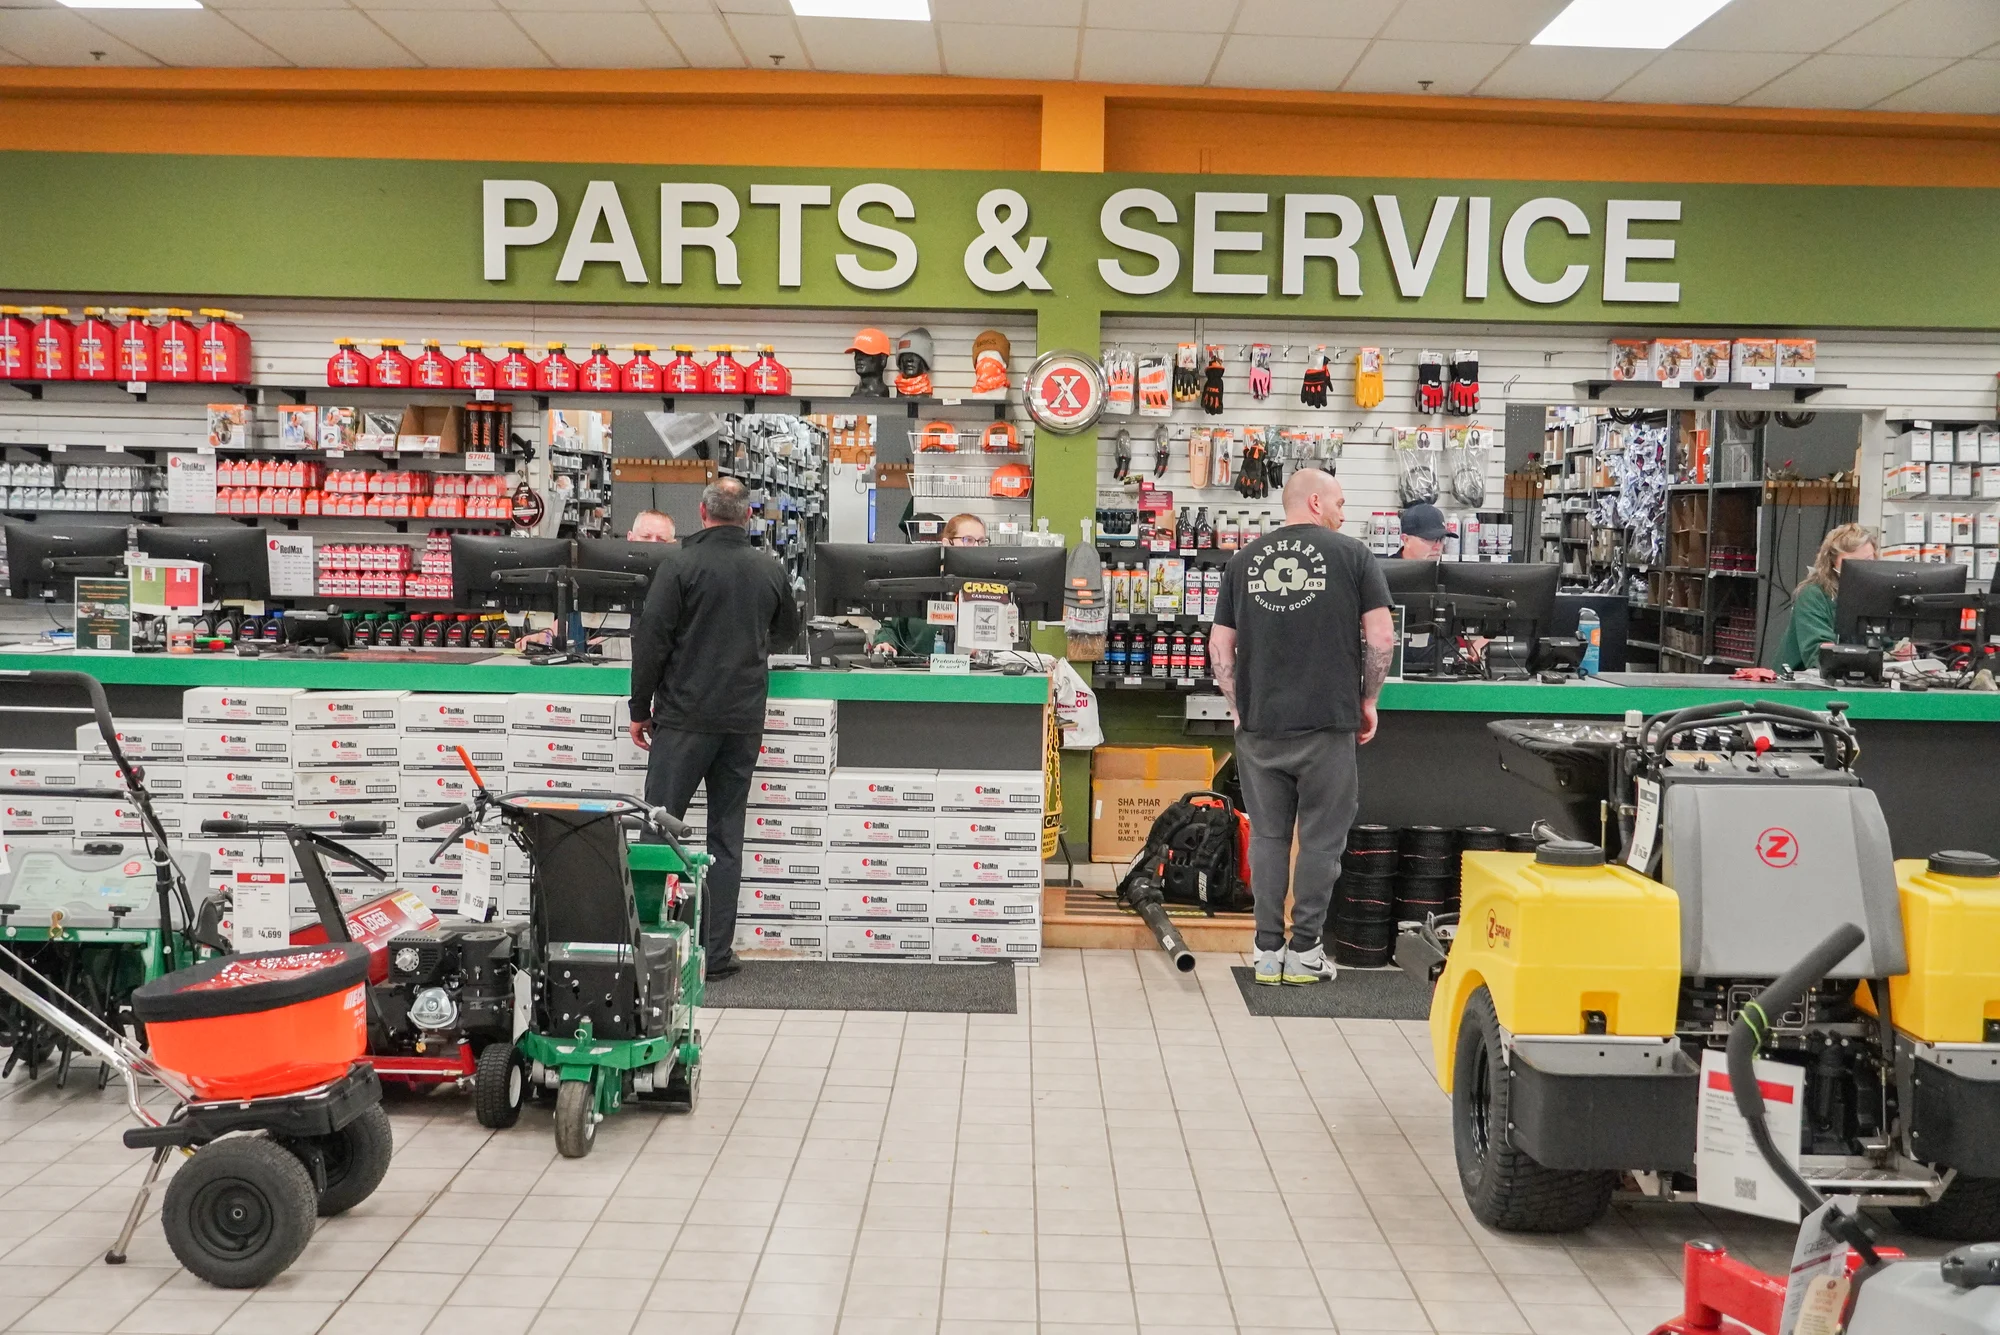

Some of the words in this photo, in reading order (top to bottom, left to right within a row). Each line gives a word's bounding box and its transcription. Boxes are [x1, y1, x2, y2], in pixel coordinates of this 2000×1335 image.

[483, 179, 918, 290] PARTS
[964, 188, 1052, 292] &
[1098, 188, 1681, 303] SERVICE
[182, 462, 206, 472] RedMax
[280, 545, 303, 554] RedMax
[1247, 540, 1327, 576] CARHARTT
[963, 581, 1009, 595] CRASH
[933, 602, 952, 611] FRIGHT
[1254, 594, 1286, 612] QUALITY
[1289, 592, 1316, 611] GOODS
[932, 657, 968, 666] Pretending
[445, 782, 463, 790] RedMax
[1118, 798, 1134, 807] SHA
[1138, 798, 1160, 807] PHAR
[1045, 815, 1060, 828] CAU
[1766, 836, 1789, 858] Z
[258, 930, 282, 939] $4,699
[1495, 924, 1512, 940] SPRAY
